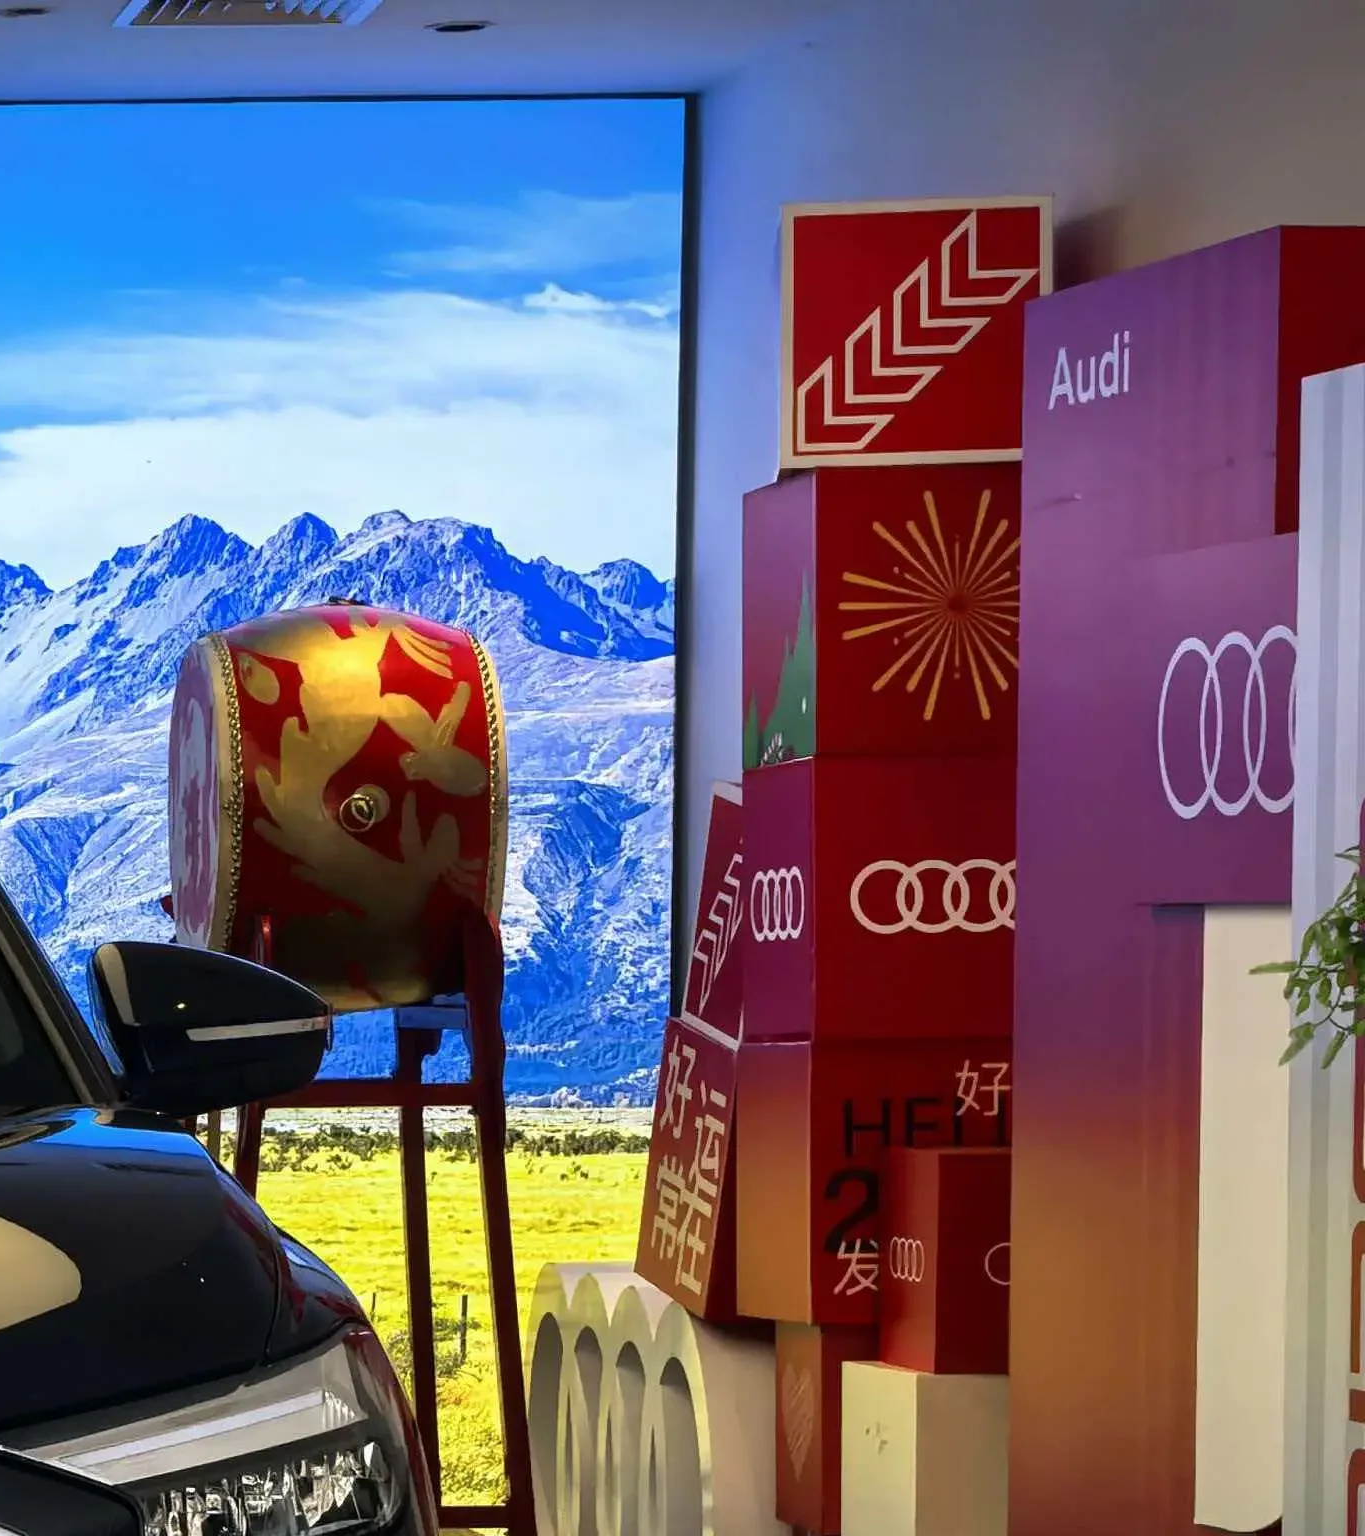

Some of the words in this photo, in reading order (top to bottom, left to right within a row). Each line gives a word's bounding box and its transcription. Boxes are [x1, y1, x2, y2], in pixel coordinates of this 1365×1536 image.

[1048, 330, 1130, 410] Audi
[659, 1034, 727, 1198] 好运
[955, 1059, 1012, 1116] 好
[651, 1154, 712, 1296] 常在
[833, 1238, 879, 1296] 发
